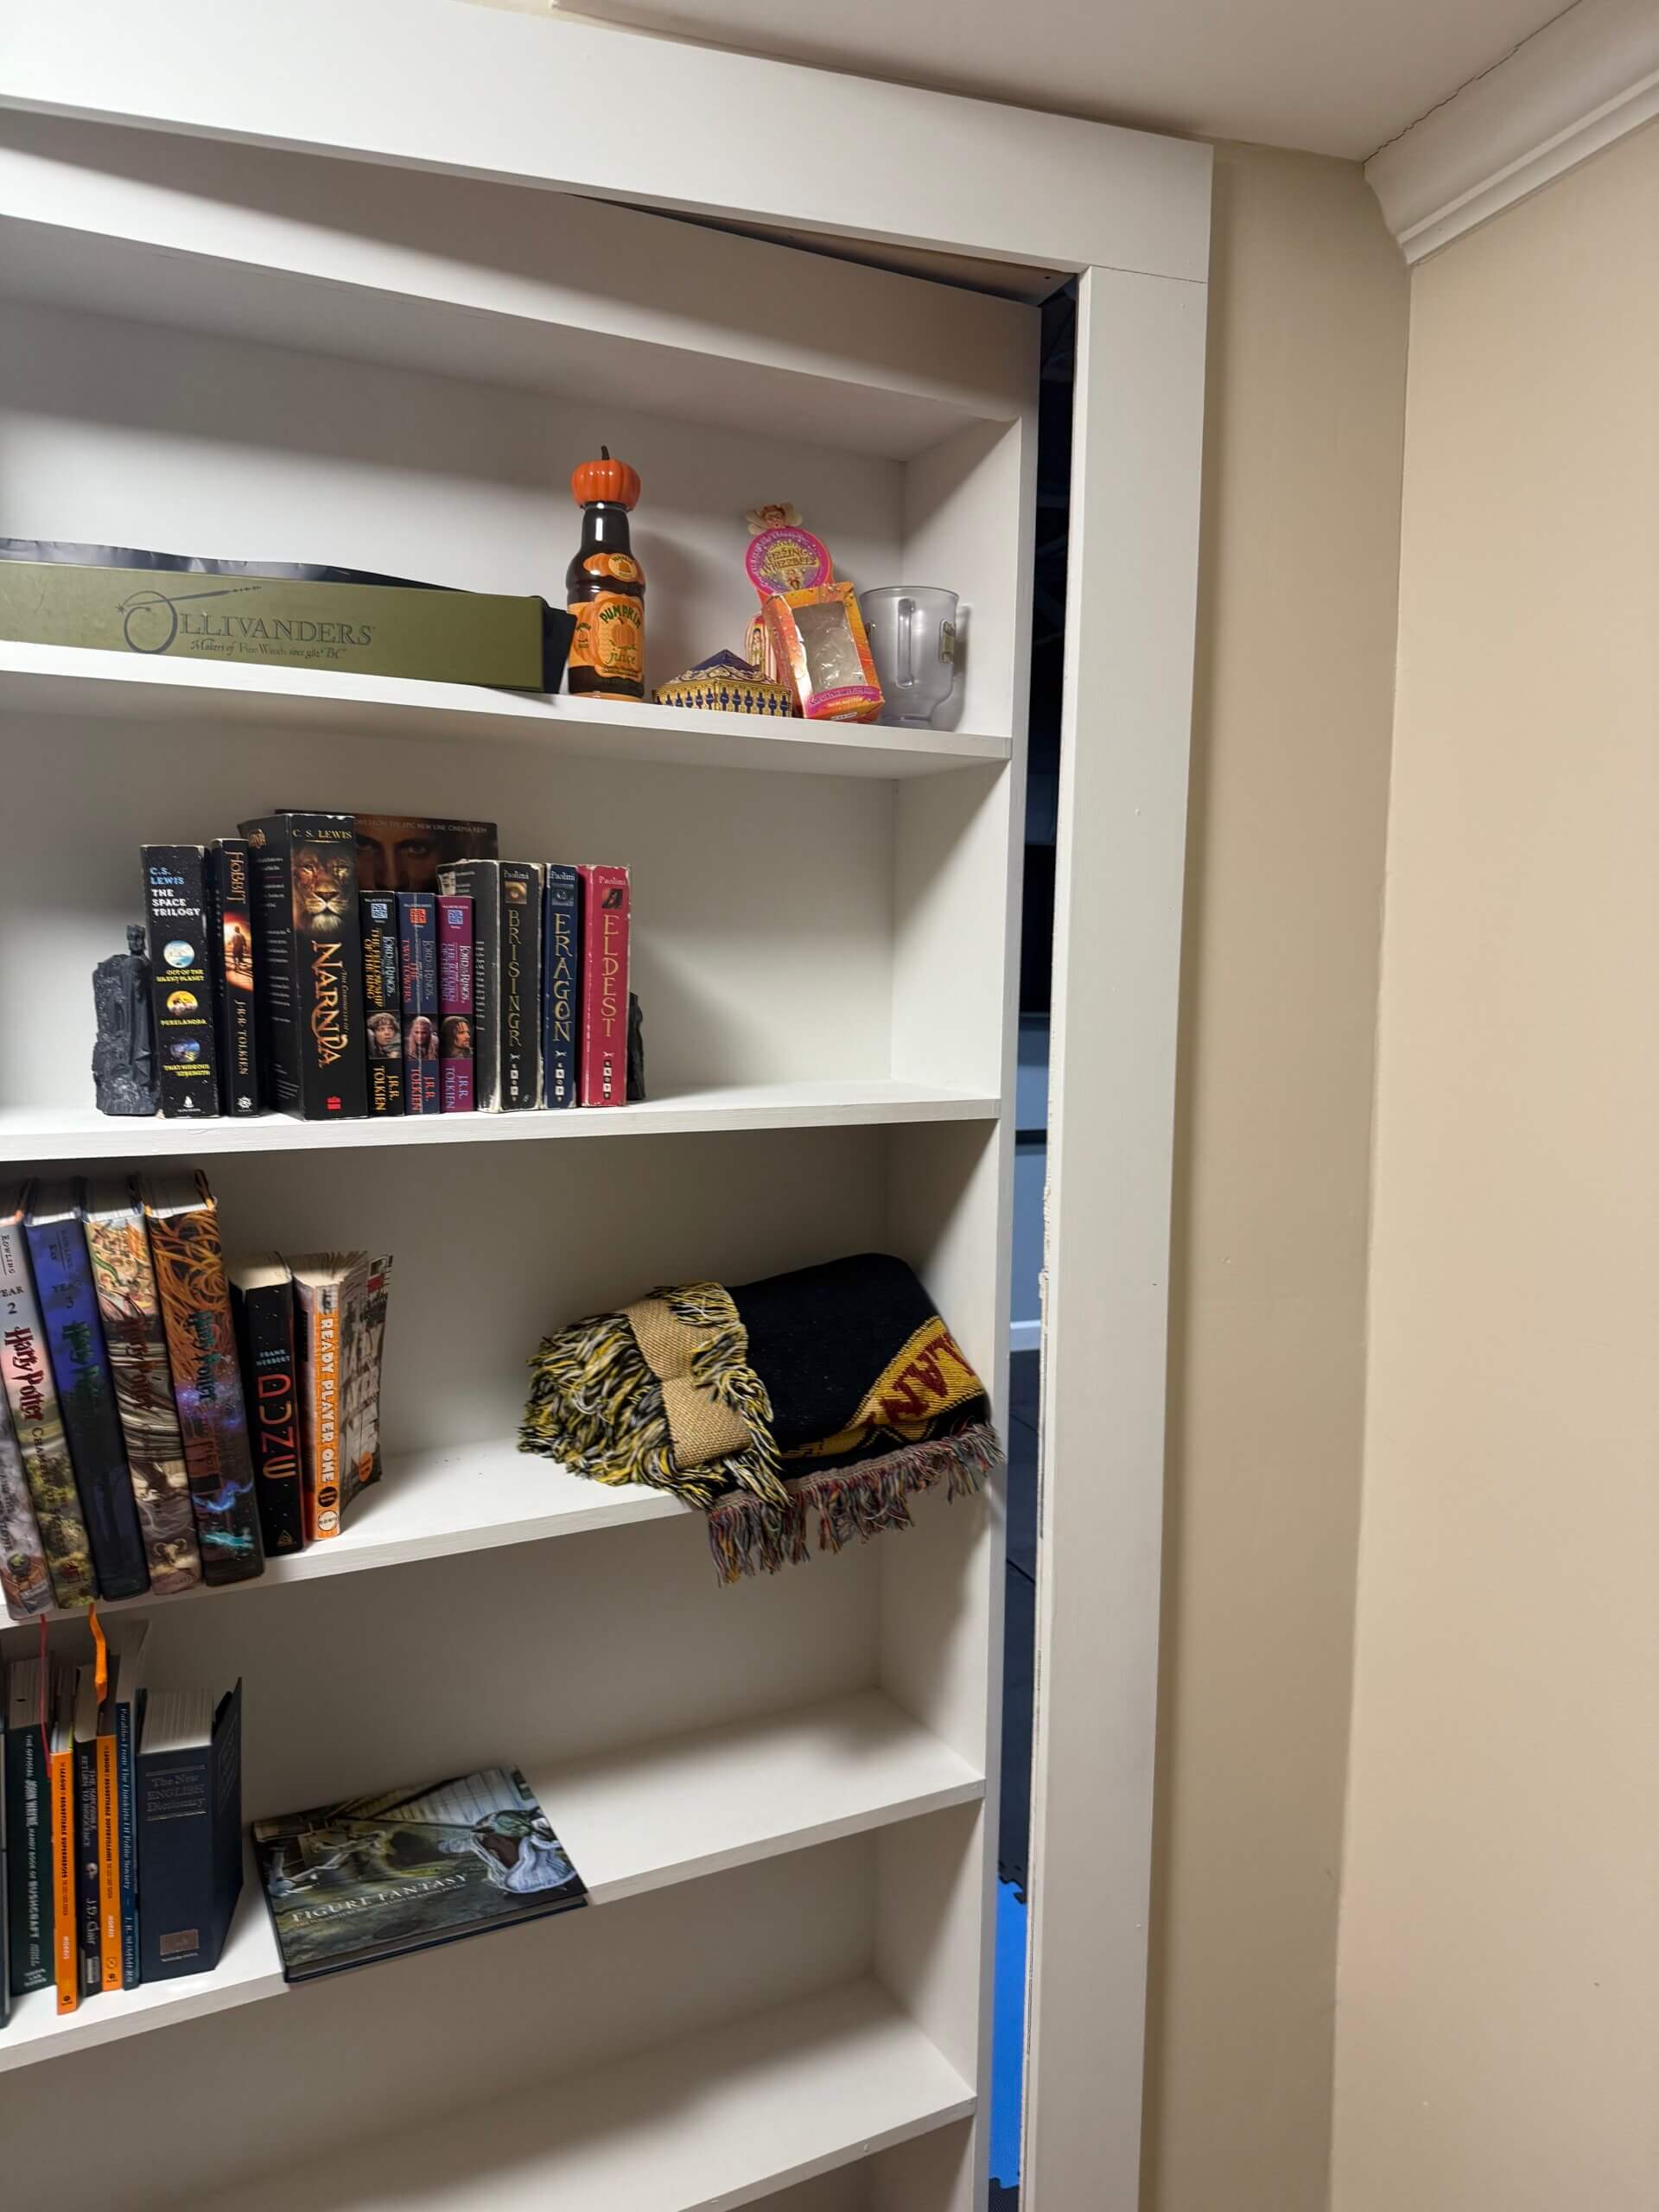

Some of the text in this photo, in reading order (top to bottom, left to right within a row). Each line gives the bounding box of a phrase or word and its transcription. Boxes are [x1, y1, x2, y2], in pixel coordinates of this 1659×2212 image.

[124, 590, 372, 654] OLLIVANDERS
[599, 603, 642, 629] PUMPKIN
[318, 830, 353, 840] LEWIS
[149, 867, 172, 876] C.S.
[150, 876, 185, 886] LEWIS
[504, 869, 530, 880] Paolini
[551, 870, 575, 881] Paolini
[598, 875, 626, 886] Paolini
[151, 888, 175, 898] THE
[151, 898, 187, 907] SPACE
[152, 908, 201, 918] TRILOGY
[402, 939, 412, 1003] TWO TOWERS
[508, 910, 522, 1047] BRISINGR
[553, 913, 574, 1043] ERAGON
[601, 914, 620, 1038] ELDEST
[310, 939, 349, 1071] NARNIA
[237, 1029, 249, 1076] TOLKIEN
[372, 1065, 387, 1111] TOLKIEN
[410, 1068, 423, 1111] TOLKIEN
[445, 1066, 456, 1109] TOLKIEN
[1, 1234, 16, 1274] ROWLING
[8, 1302, 17, 1314] 2
[256, 1355, 291, 1366] HERBERT
[260, 1349, 286, 1358] FRANK
[321, 1318, 334, 1374] READY
[4, 1325, 47, 1422] Harry Potter
[321, 1379, 335, 1443] PLAYER
[321, 1447, 335, 1483] ONE
[147, 1784, 205, 1801] ENGLISH
[152, 1774, 200, 1788] The New
[147, 1797, 207, 1813] Dictionary
[28, 1880, 40, 1938] BUSHCRAFT
[291, 1897, 372, 1923] FIGURE
[378, 1873, 467, 1901] FANTASY
